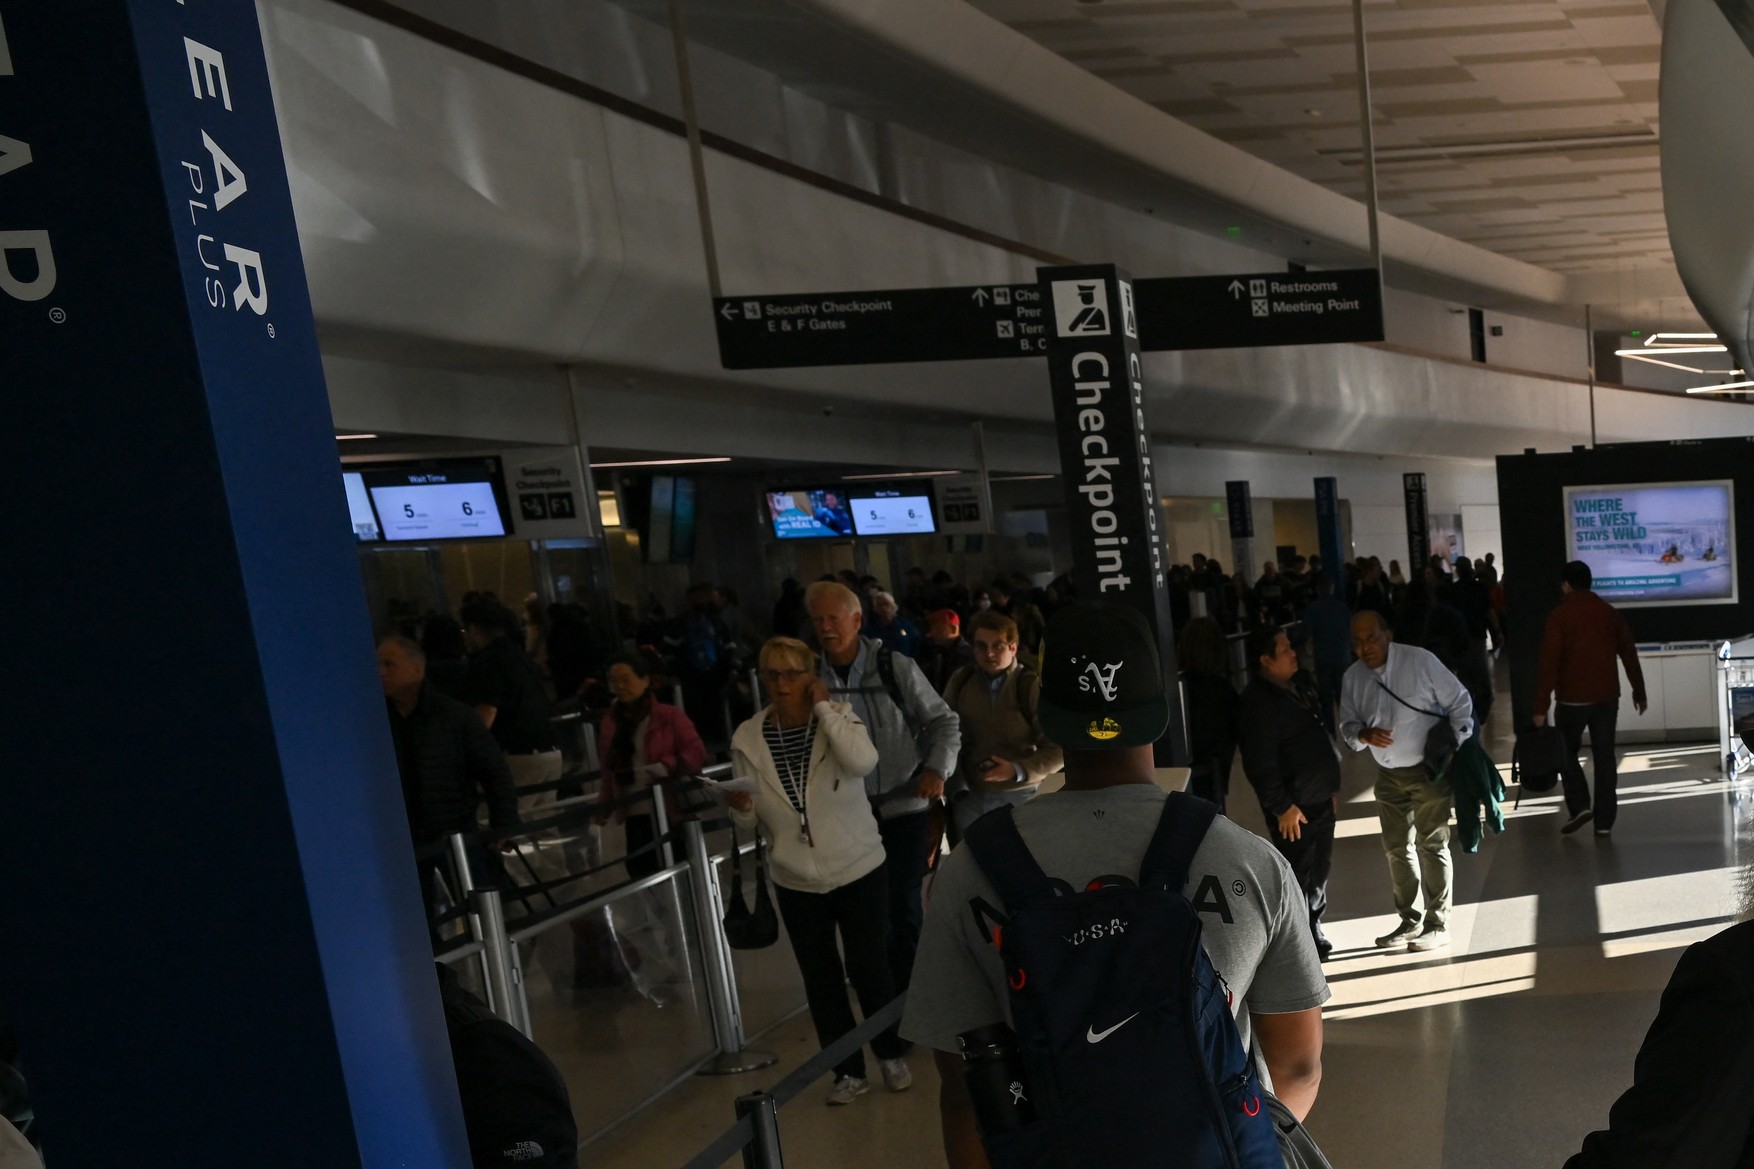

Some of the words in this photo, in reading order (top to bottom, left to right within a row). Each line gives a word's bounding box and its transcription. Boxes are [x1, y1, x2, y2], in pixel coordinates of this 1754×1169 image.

[181, 160, 226, 309] PLUS
[1270, 281, 1338, 294] Restrooms
[1014, 289, 1040, 302] Che
[765, 303, 817, 317] Security
[821, 300, 892, 315] Checkpoint
[1016, 307, 1042, 318] Pre
[1272, 301, 1324, 315] Meeting
[1327, 298, 1360, 311] Point
[768, 321, 776, 332] E
[780, 320, 792, 332] &
[797, 319, 805, 331] F
[809, 318, 847, 331] Gates
[1018, 322, 1044, 334] Ter
[1071, 351, 1131, 593] Checkpoint
[1130, 352, 1164, 589] Checkpoint
[407, 474, 426, 484] Wait
[427, 473, 447, 484] Time
[403, 503, 414, 518] 5
[462, 501, 473, 516] 6
[1574, 498, 1623, 513] WHERE
[870, 511, 878, 520] 5
[908, 509, 915, 519] 6
[1575, 516, 1596, 528] THE
[1599, 512, 1637, 527] WEST
[1576, 530, 1610, 542] STAYS
[1612, 527, 1647, 540] WILD
[515, 1141, 530, 1149] THE
[503, 1148, 534, 1158] NORTH
